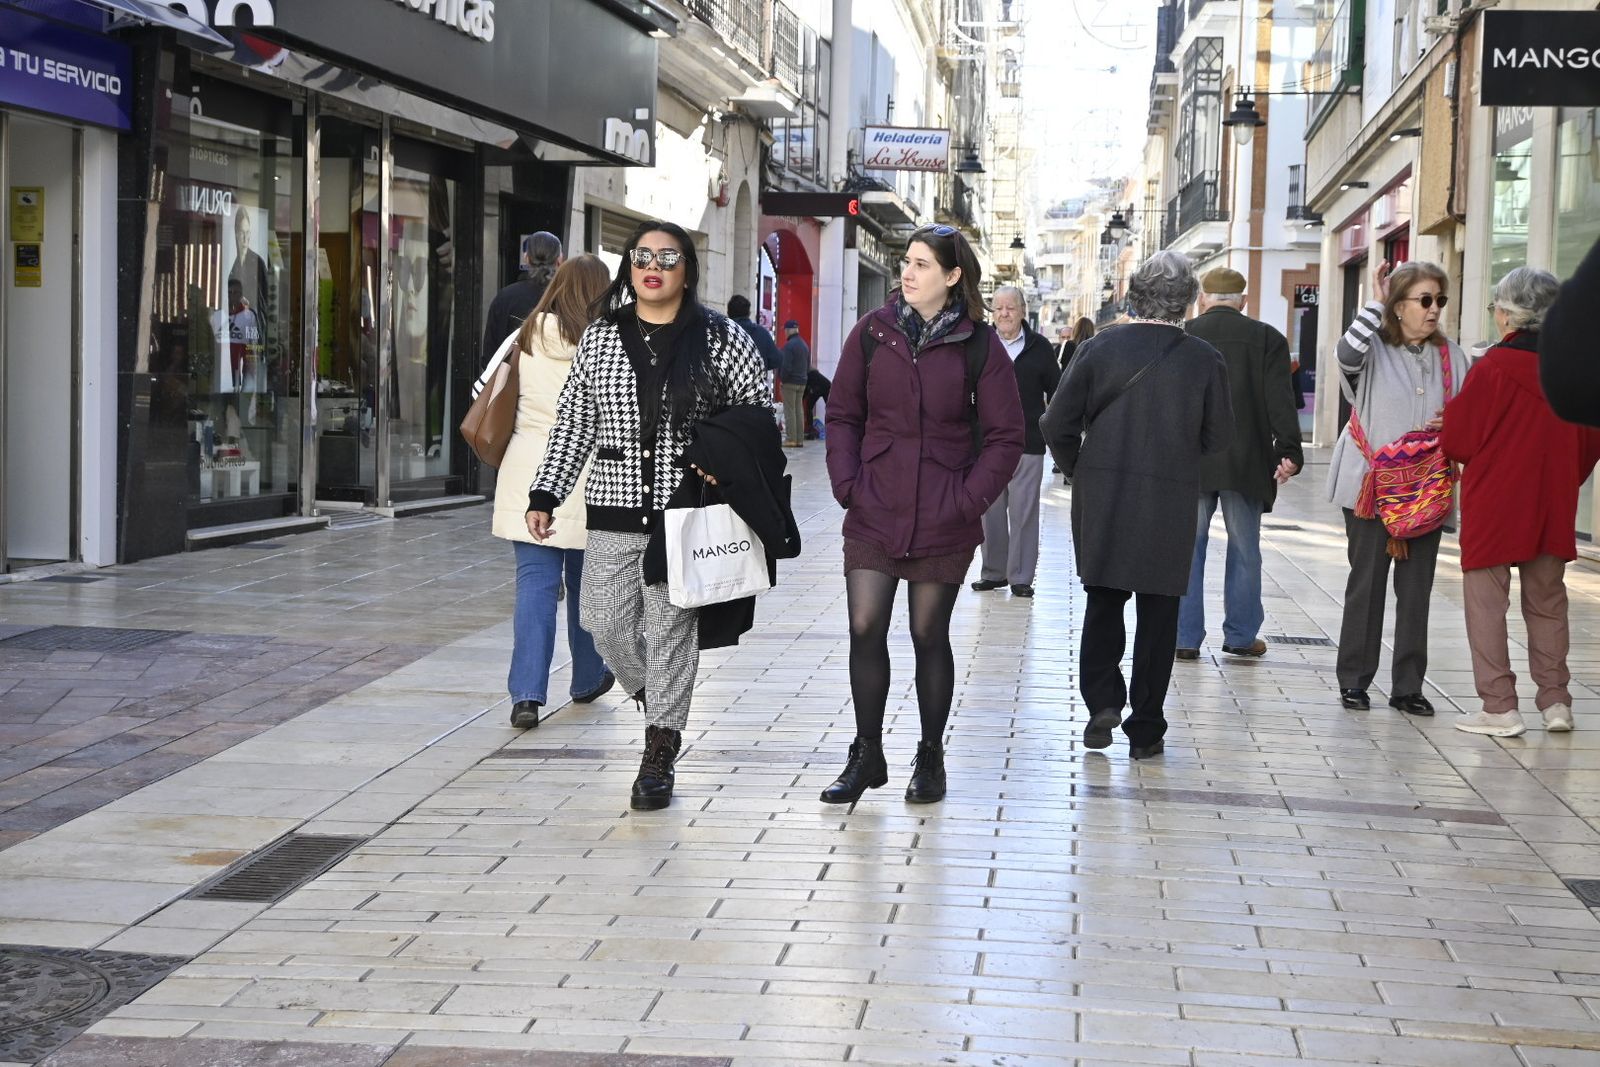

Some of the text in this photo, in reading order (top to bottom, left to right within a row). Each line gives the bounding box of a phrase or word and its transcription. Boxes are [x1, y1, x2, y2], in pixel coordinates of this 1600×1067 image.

[10, 49, 39, 75] TU
[43, 58, 121, 95] SERVICIO
[867, 146, 891, 165] La
[692, 540, 751, 561] MANGO
